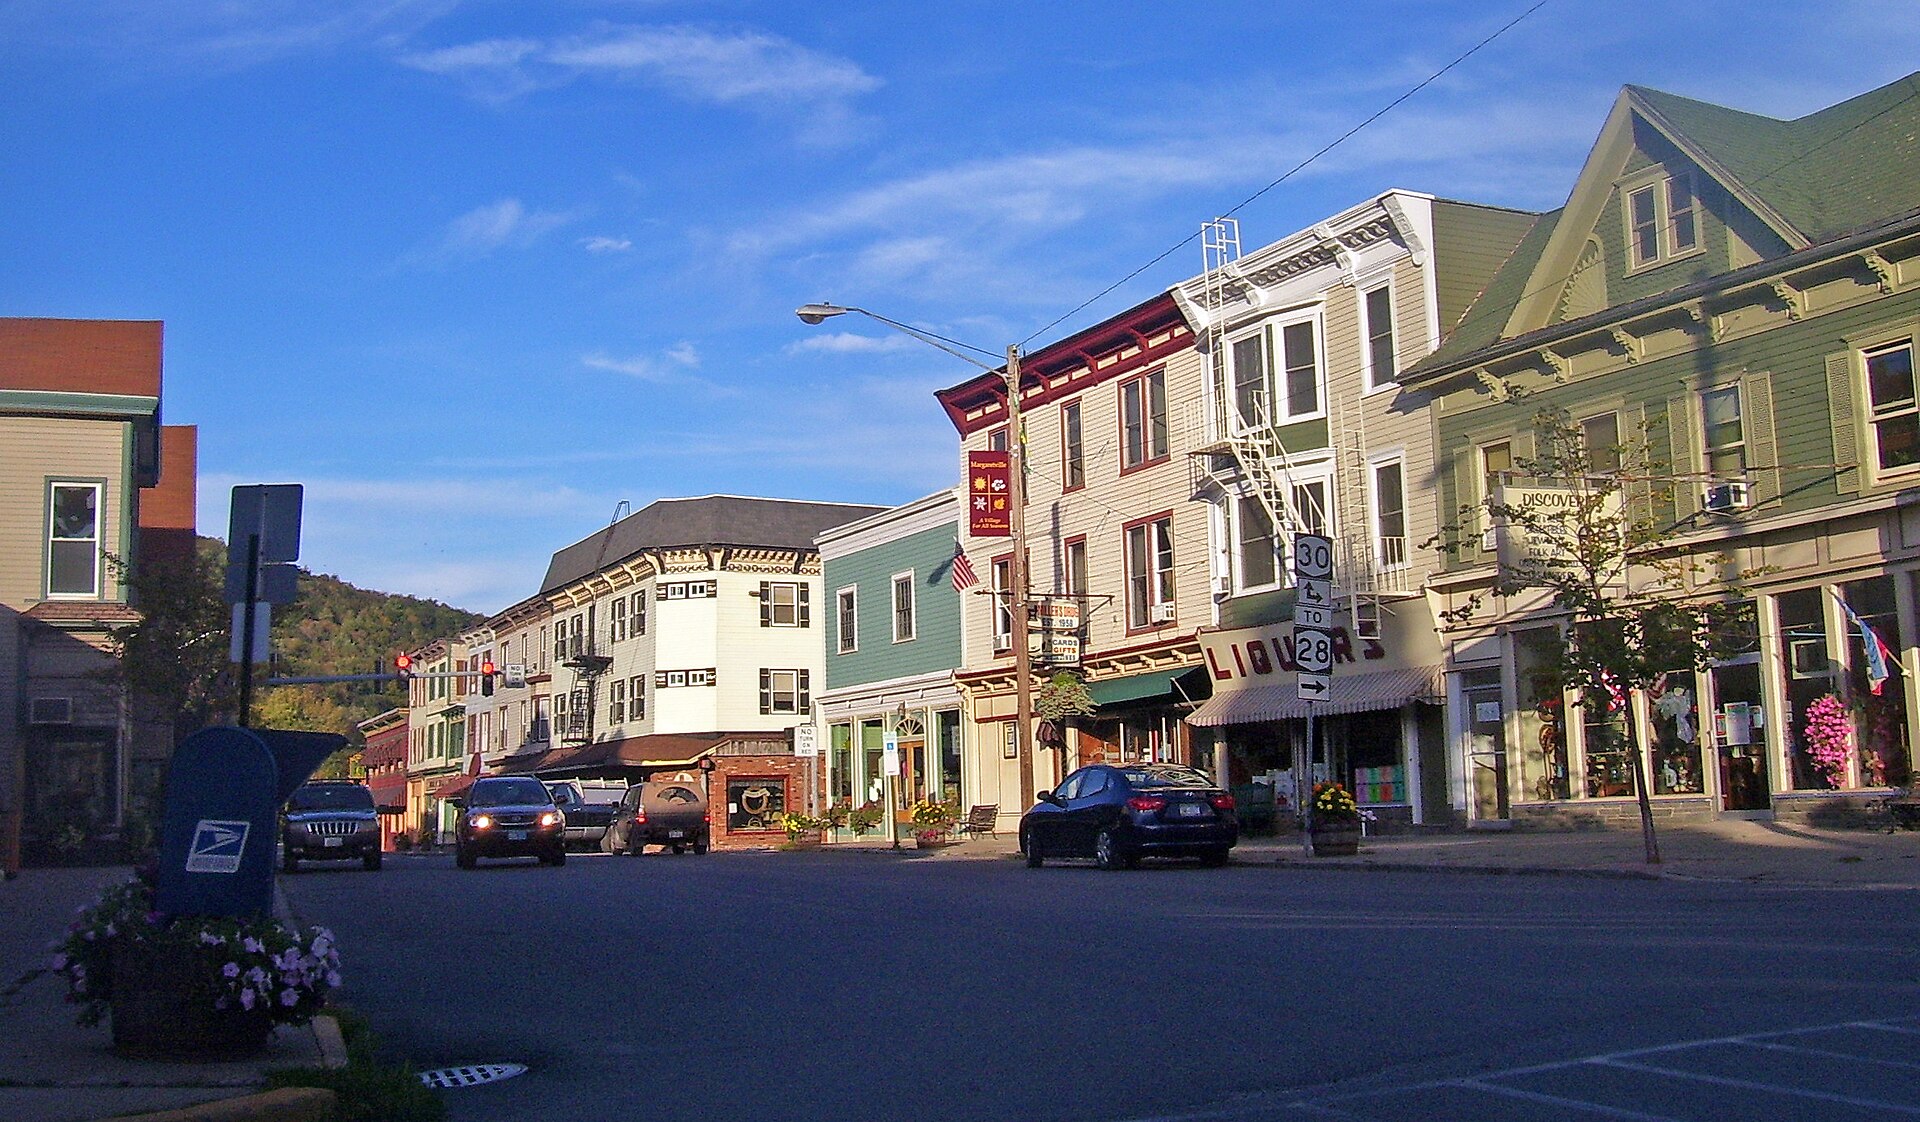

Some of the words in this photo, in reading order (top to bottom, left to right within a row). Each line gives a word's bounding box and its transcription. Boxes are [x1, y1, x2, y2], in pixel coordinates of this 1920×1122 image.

[1299, 543, 1329, 569] 30
[1529, 548, 1548, 557] FOLK
[1550, 548, 1565, 557] ART
[1303, 610, 1322, 623] TO
[1206, 604, 1385, 680] LIQURS
[1298, 637, 1329, 664] 28
